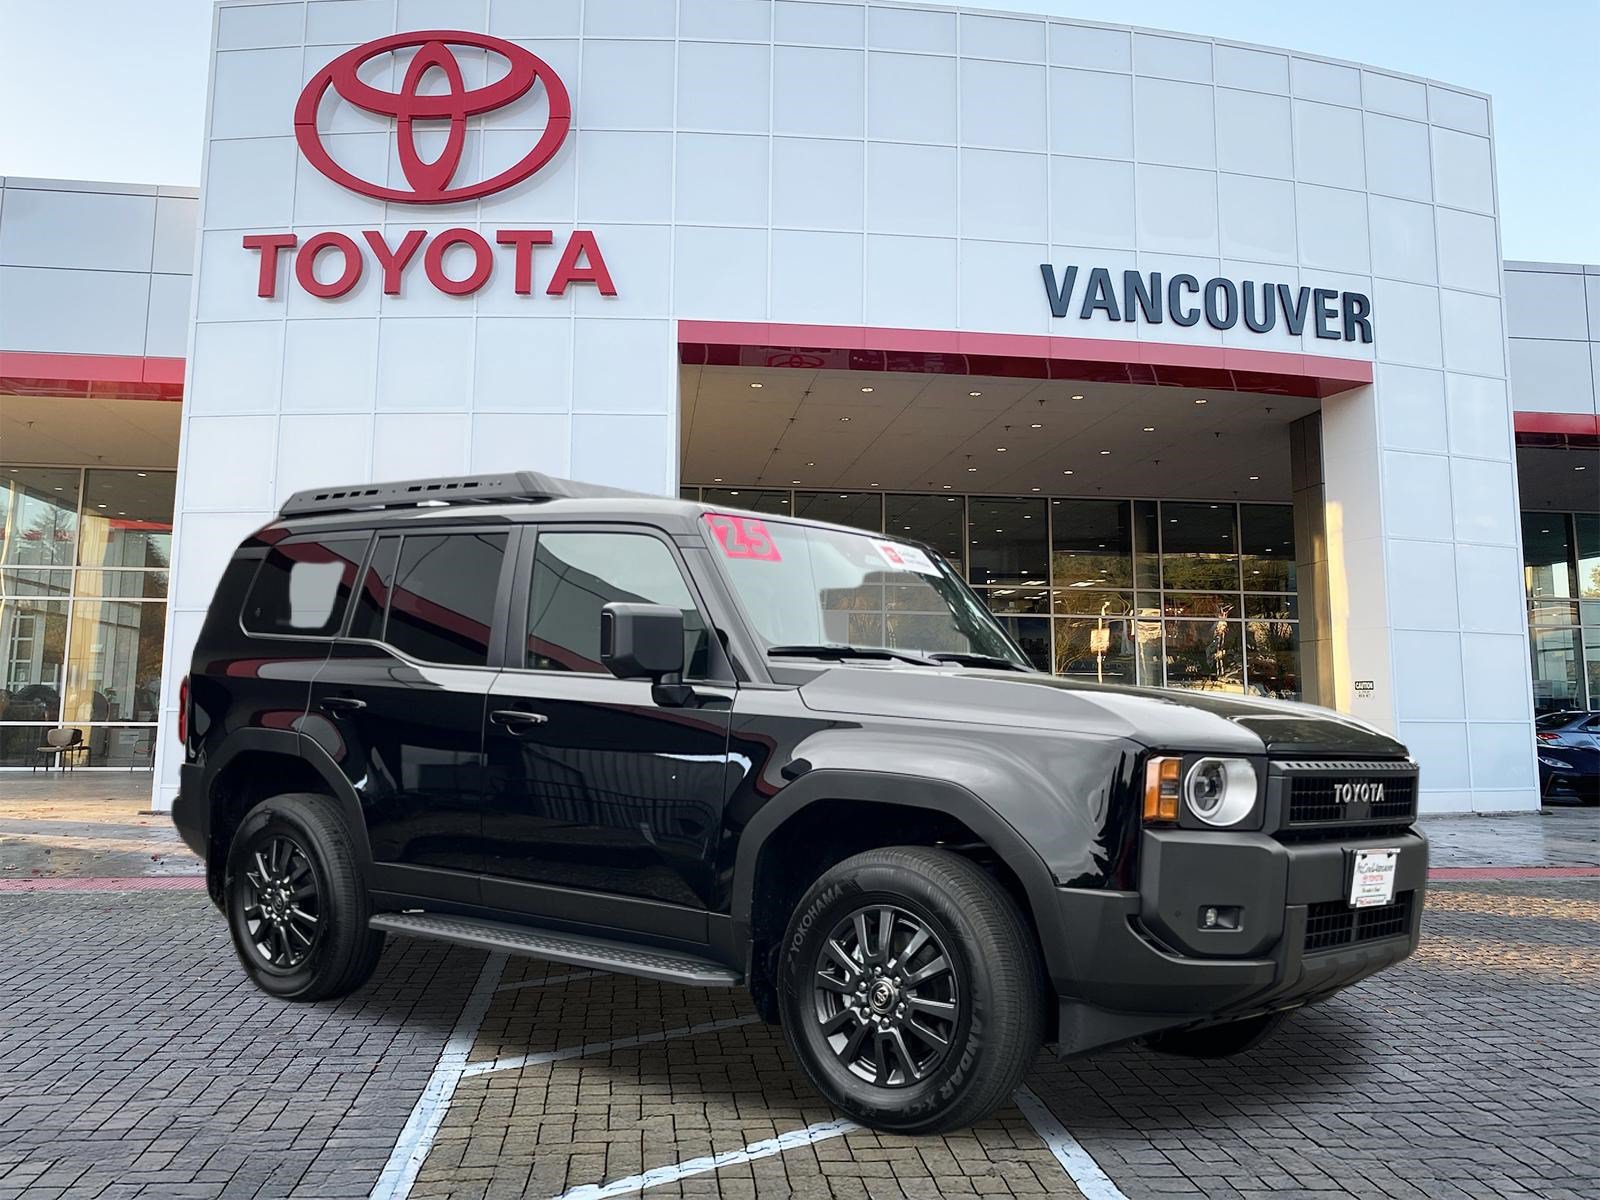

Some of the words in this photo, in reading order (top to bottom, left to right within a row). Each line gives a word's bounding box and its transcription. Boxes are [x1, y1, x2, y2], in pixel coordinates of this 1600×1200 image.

[243, 228, 617, 298] TOYOTA
[1040, 264, 1373, 343] VANCOUVER
[711, 517, 770, 554] 25
[1334, 783, 1385, 803] TOYOTA
[790, 883, 843, 953] YOKOHAMA
